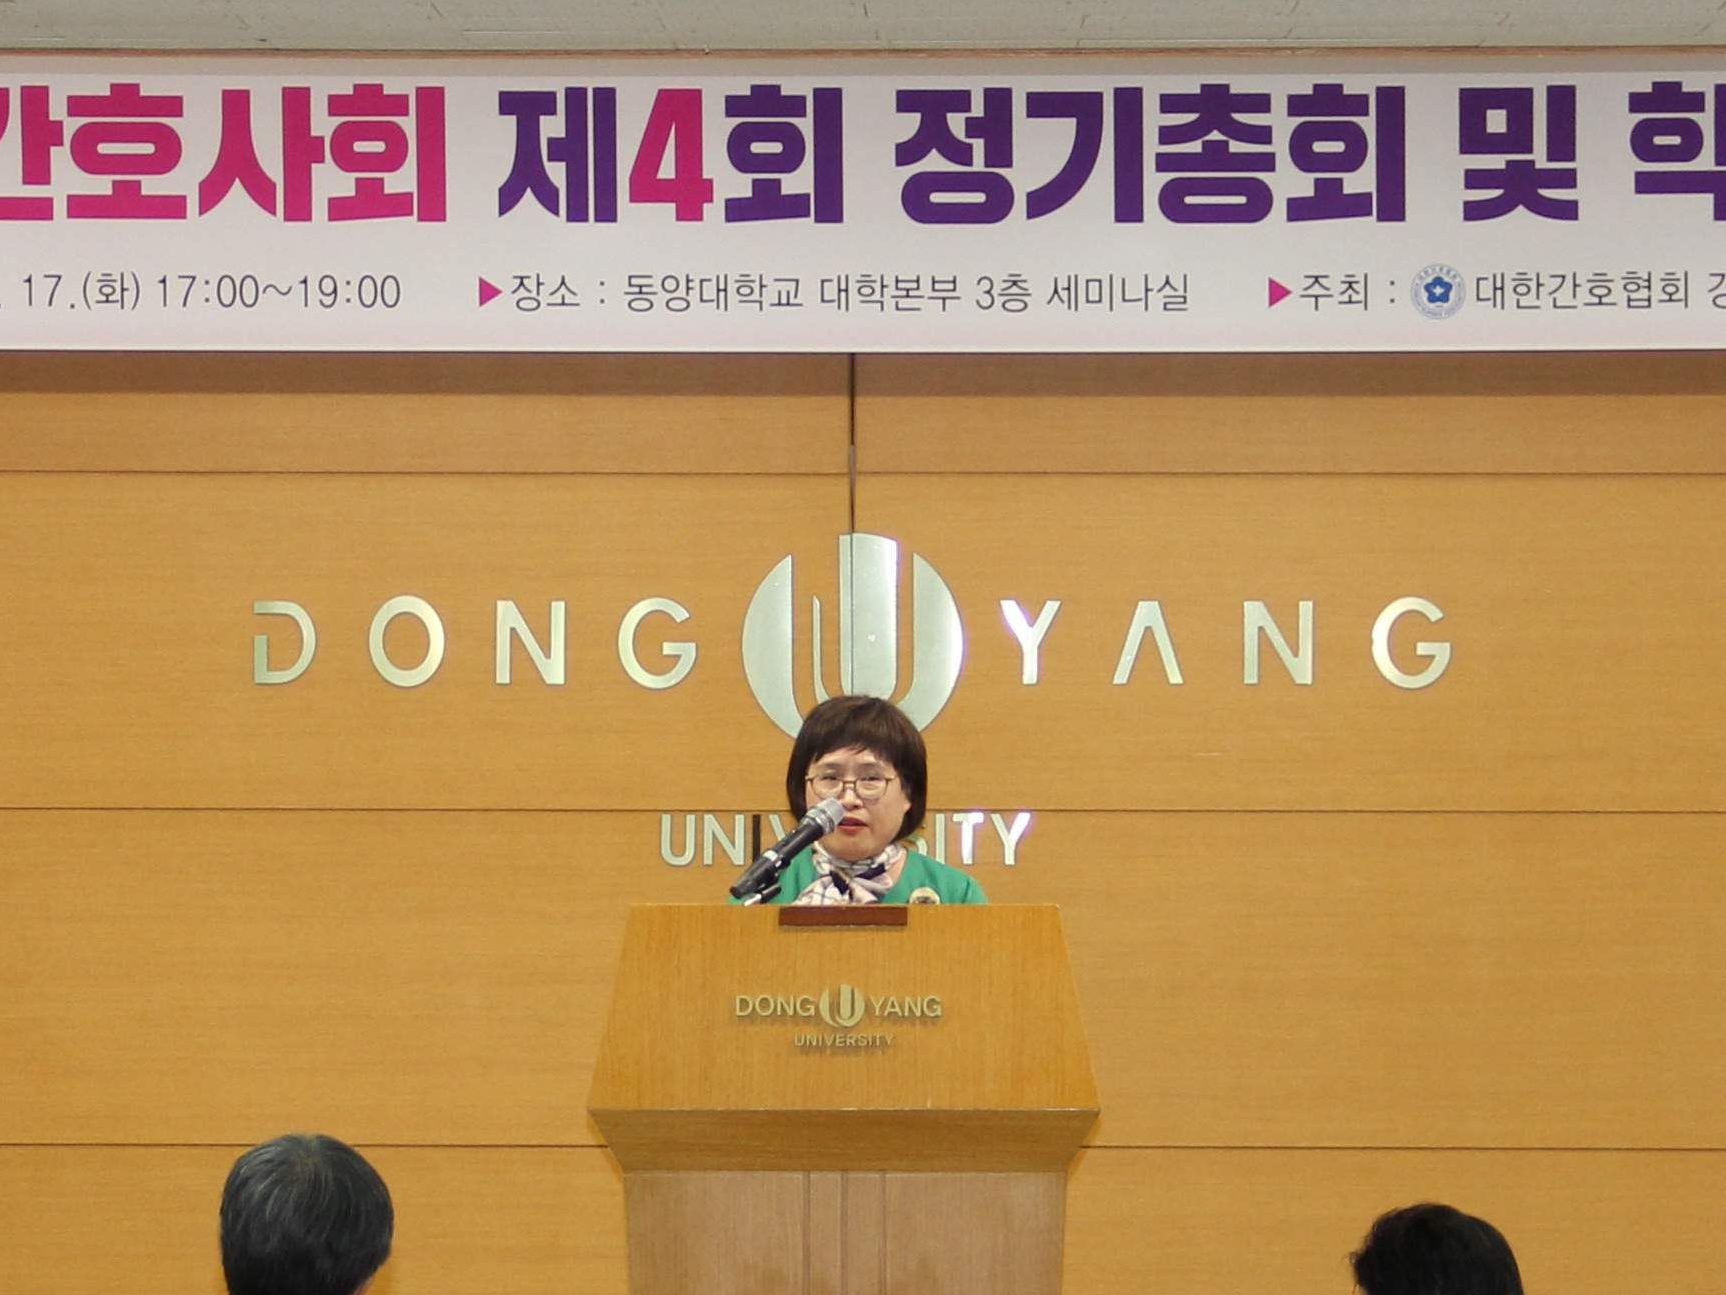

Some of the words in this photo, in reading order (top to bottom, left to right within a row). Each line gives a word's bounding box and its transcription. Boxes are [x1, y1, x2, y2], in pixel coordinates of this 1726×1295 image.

[496, 83, 845, 224] 제4회
[893, 83, 1407, 225] 정기총회
[1458, 83, 1580, 222] 및
[22, 271, 141, 311] 17.(화)
[157, 273, 402, 310] 17:00~19:00
[510, 272, 581, 312] 장소
[623, 272, 804, 313] 동양대학교
[819, 273, 962, 313] 대학본부
[975, 272, 1033, 313] 3층
[1045, 273, 1189, 312] 세미나실
[1298, 272, 1370, 312] 주최
[1474, 270, 1690, 311] 대한간호협회
[252, 595, 698, 689] DONG
[1000, 595, 1452, 690] YANG
[659, 811, 1031, 867] UNIITY
[735, 994, 816, 1018] DONG
[869, 995, 943, 1018] YANG
[793, 1033, 896, 1048] UNIVERSITY
